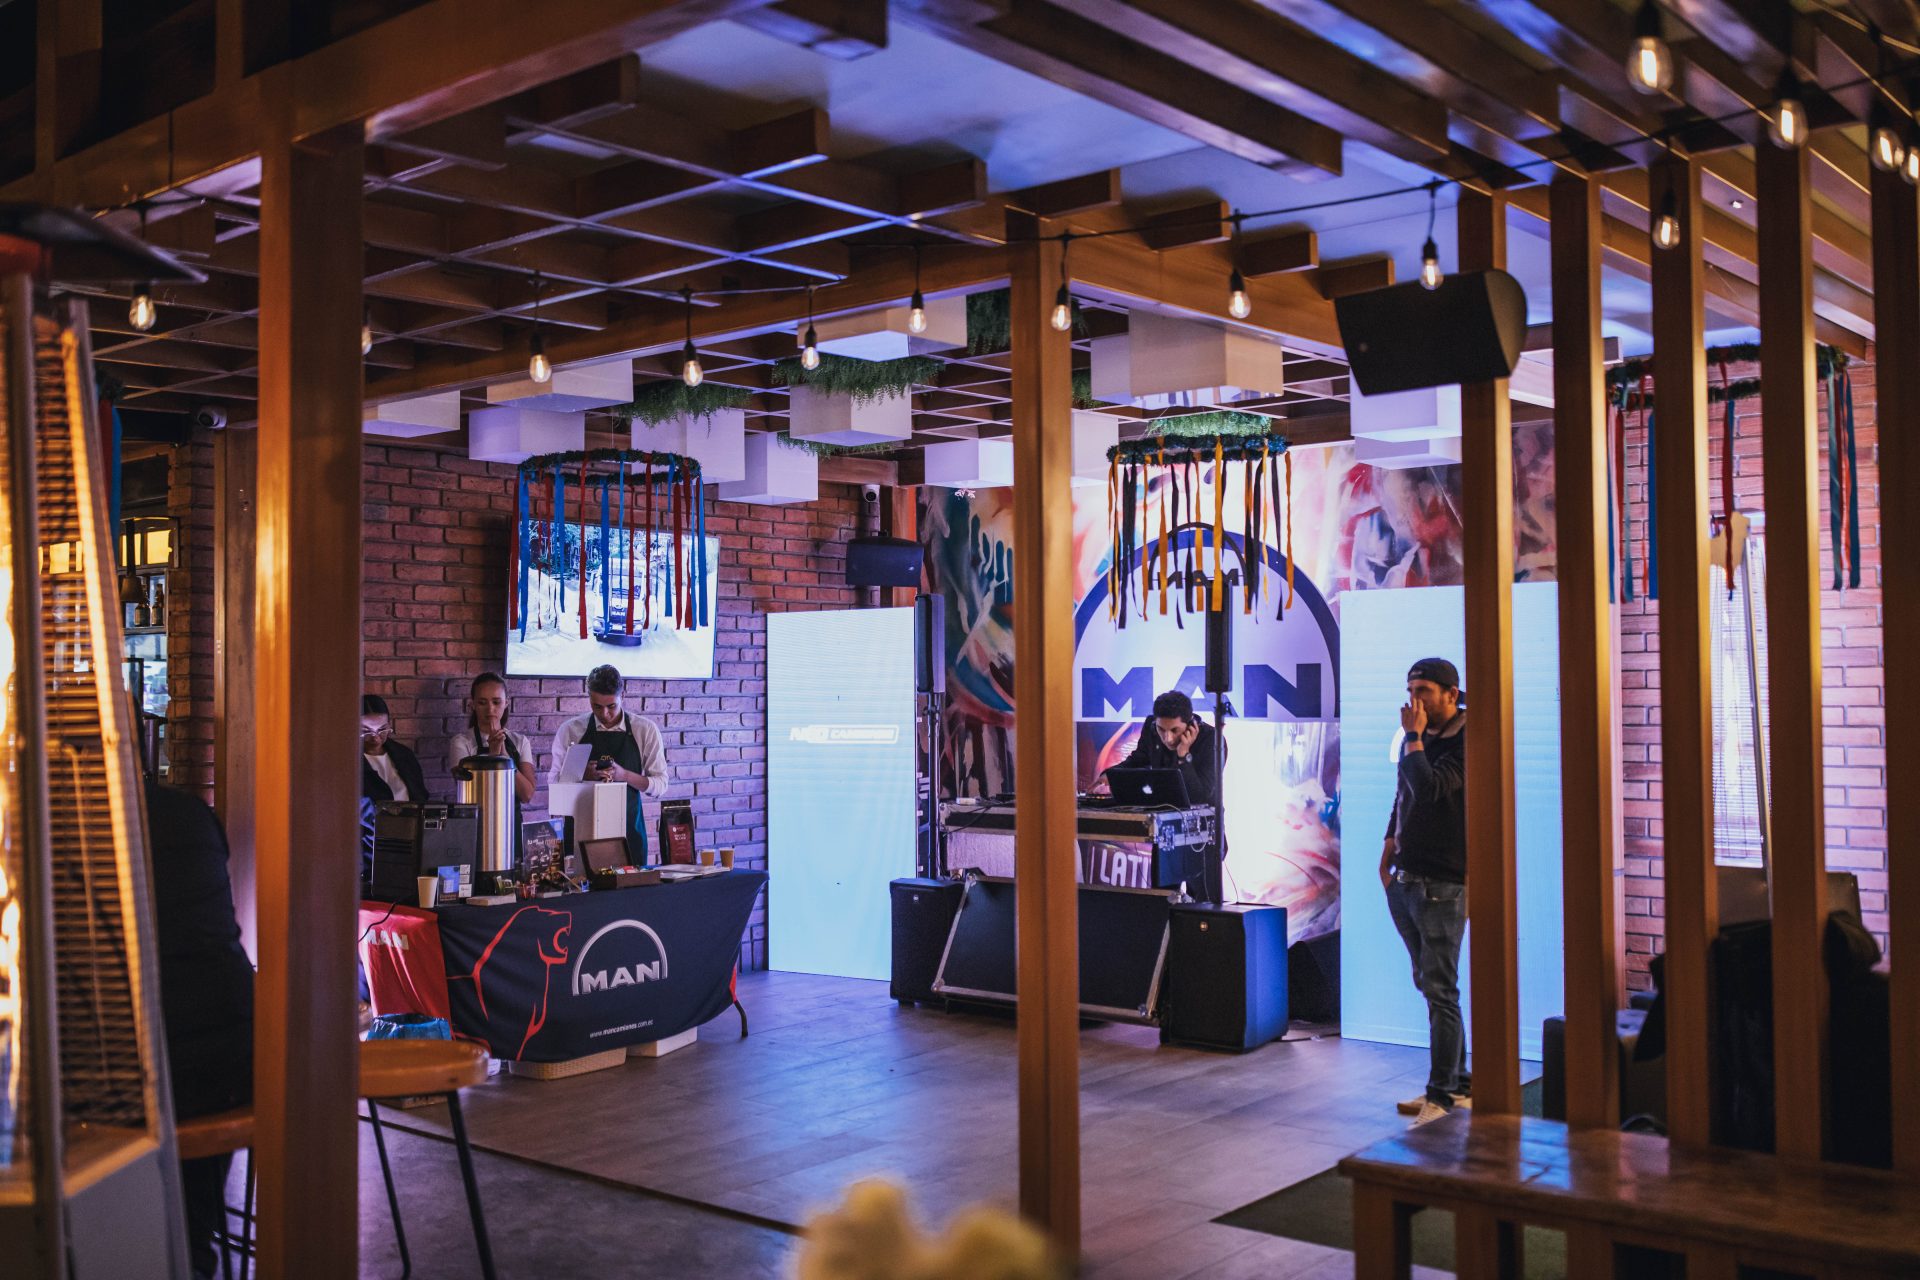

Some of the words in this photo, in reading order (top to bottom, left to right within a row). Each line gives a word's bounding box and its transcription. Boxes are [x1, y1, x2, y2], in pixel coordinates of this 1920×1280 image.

[1082, 663, 1321, 718] MAN
[1100, 848, 1152, 889] LATI
[362, 928, 410, 951] MAN
[580, 960, 661, 995] MAN
